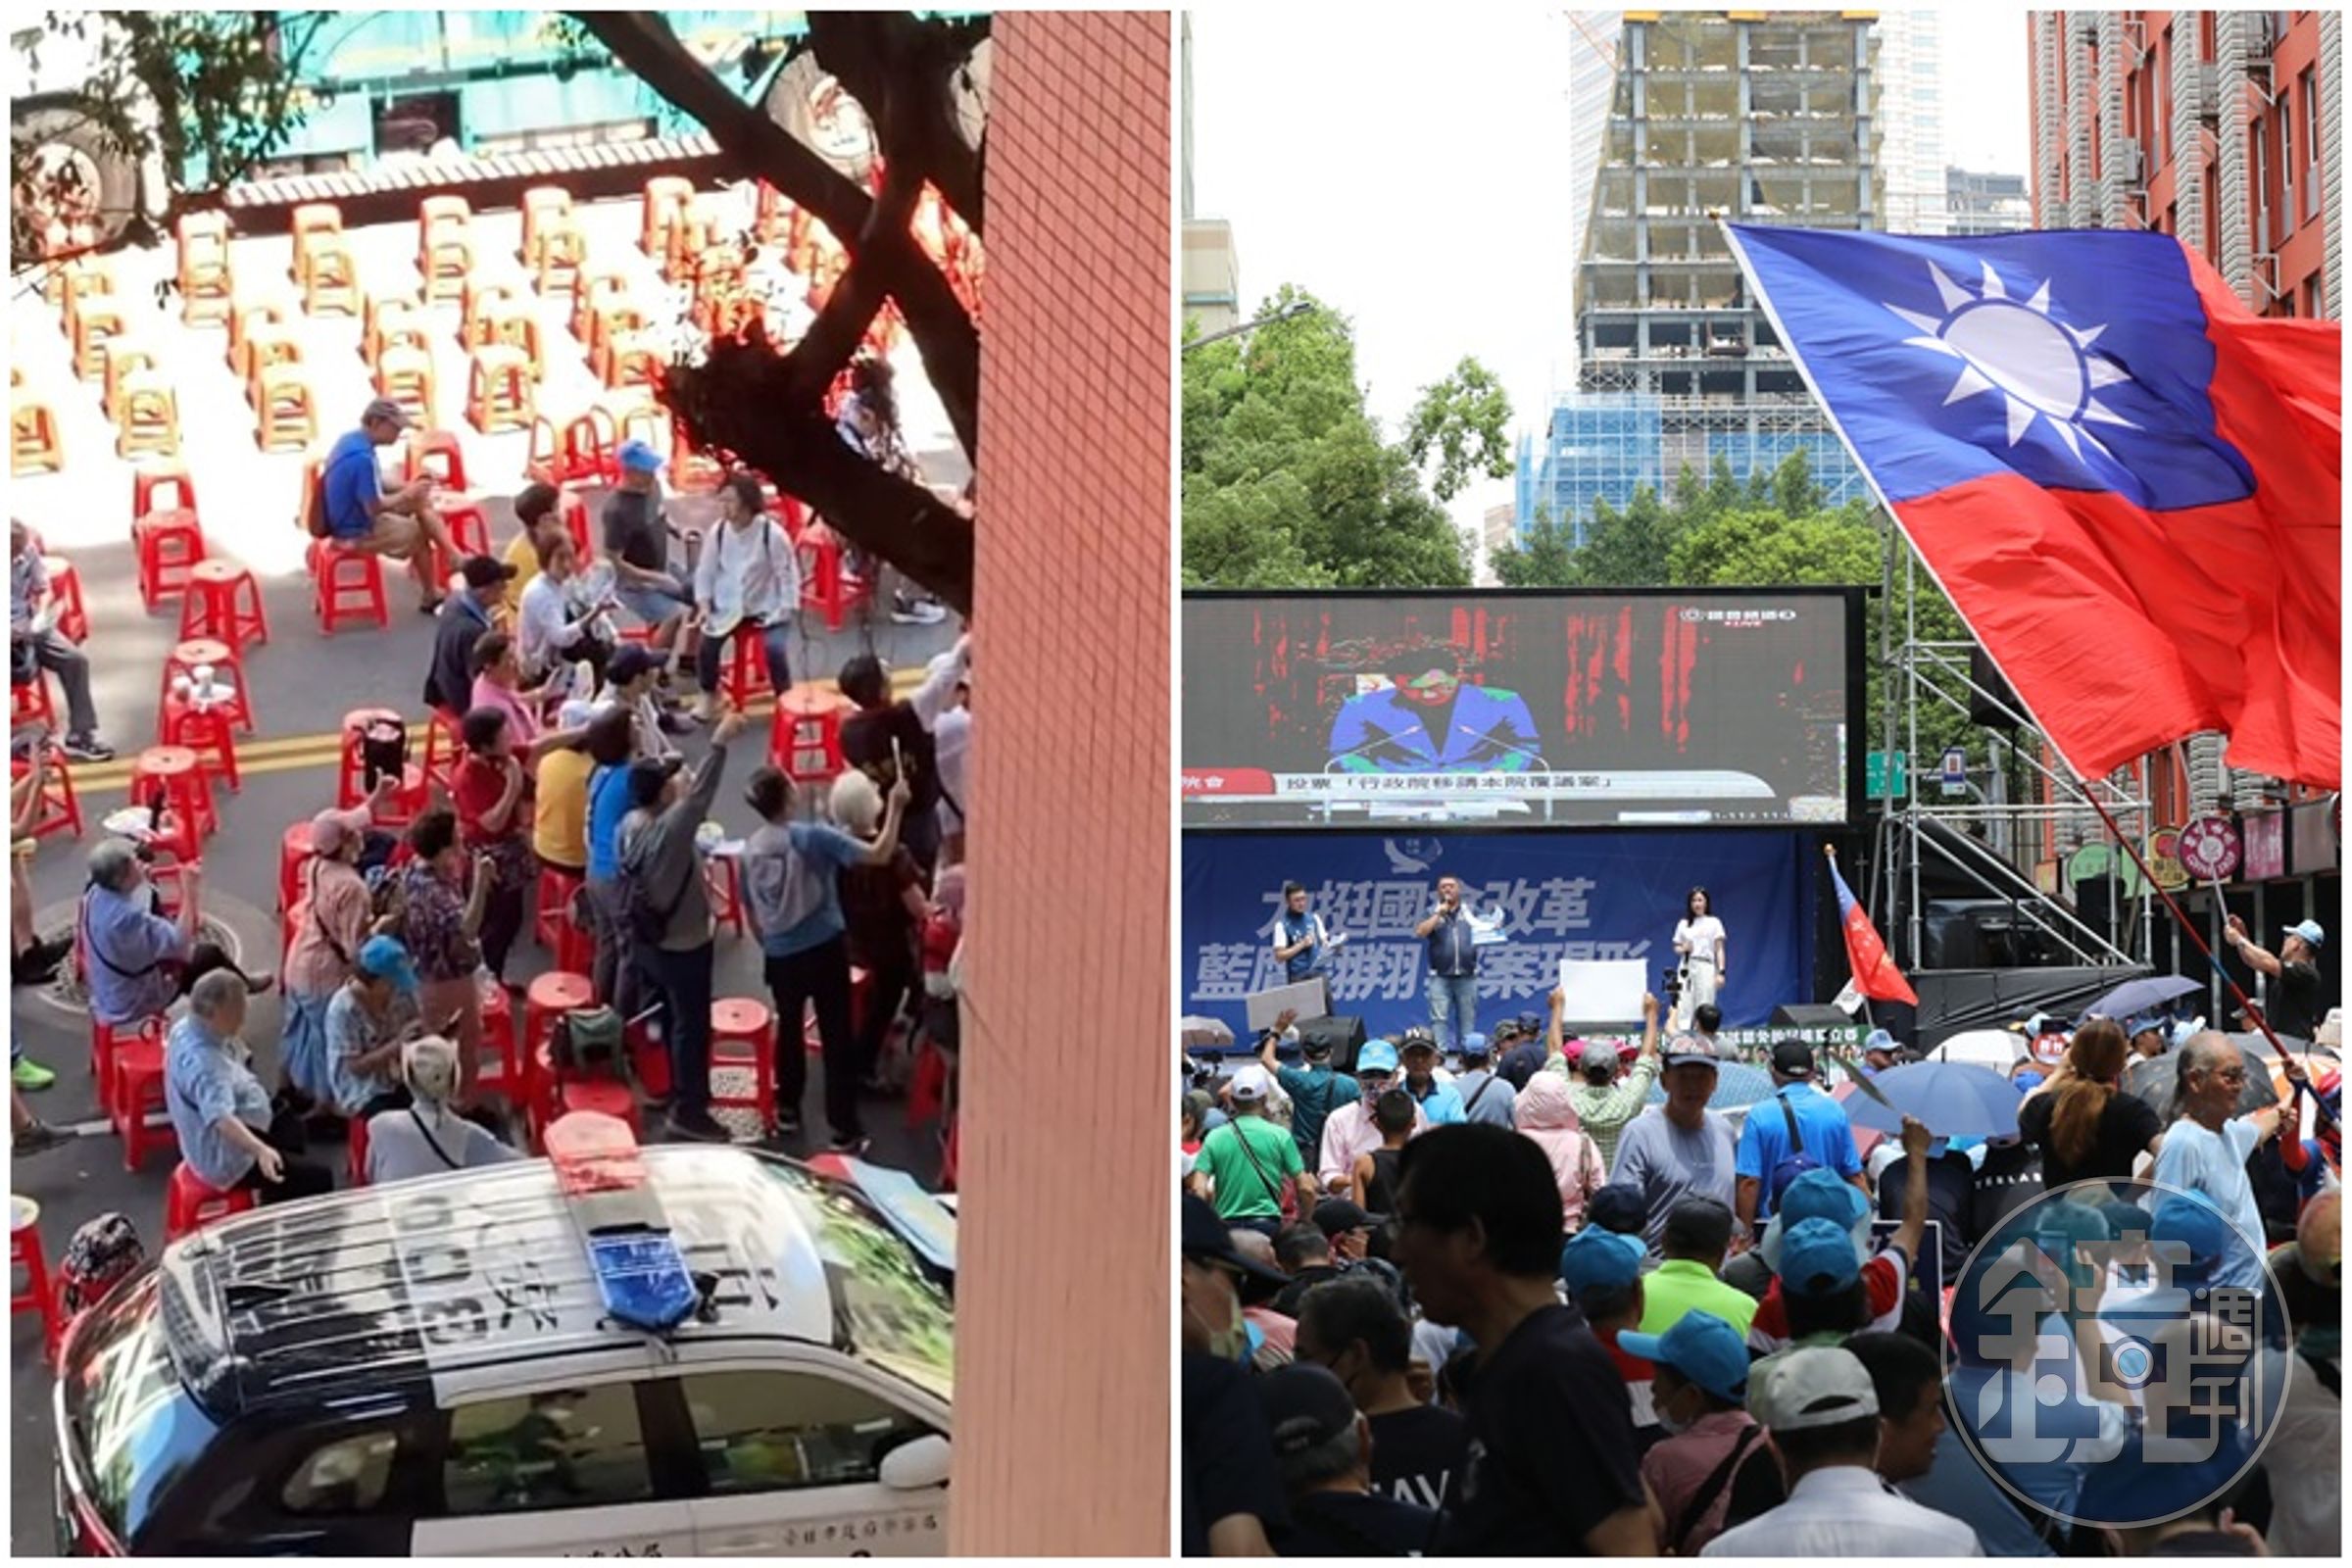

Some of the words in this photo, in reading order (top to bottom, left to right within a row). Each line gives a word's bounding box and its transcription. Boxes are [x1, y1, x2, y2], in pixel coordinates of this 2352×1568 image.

[1255, 877, 1596, 939] 力挺國改革
